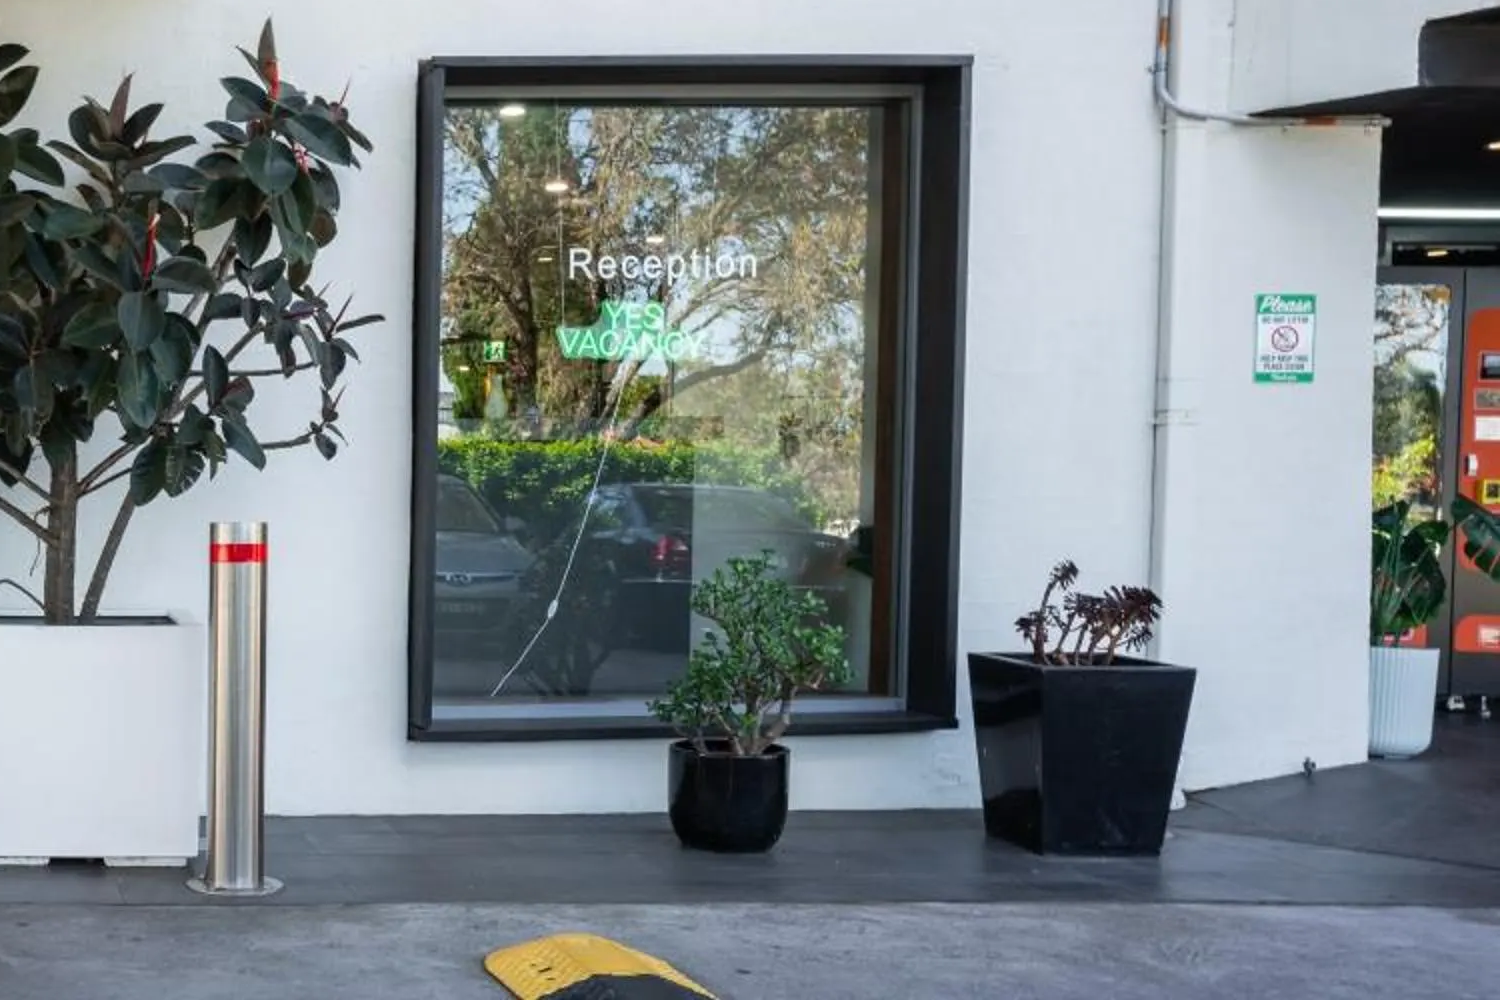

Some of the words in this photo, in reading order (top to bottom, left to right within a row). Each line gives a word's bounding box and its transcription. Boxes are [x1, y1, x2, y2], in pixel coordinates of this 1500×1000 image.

[568, 247, 758, 285] Reception
[604, 301, 665, 330] YES
[558, 328, 706, 358] VACANCY
